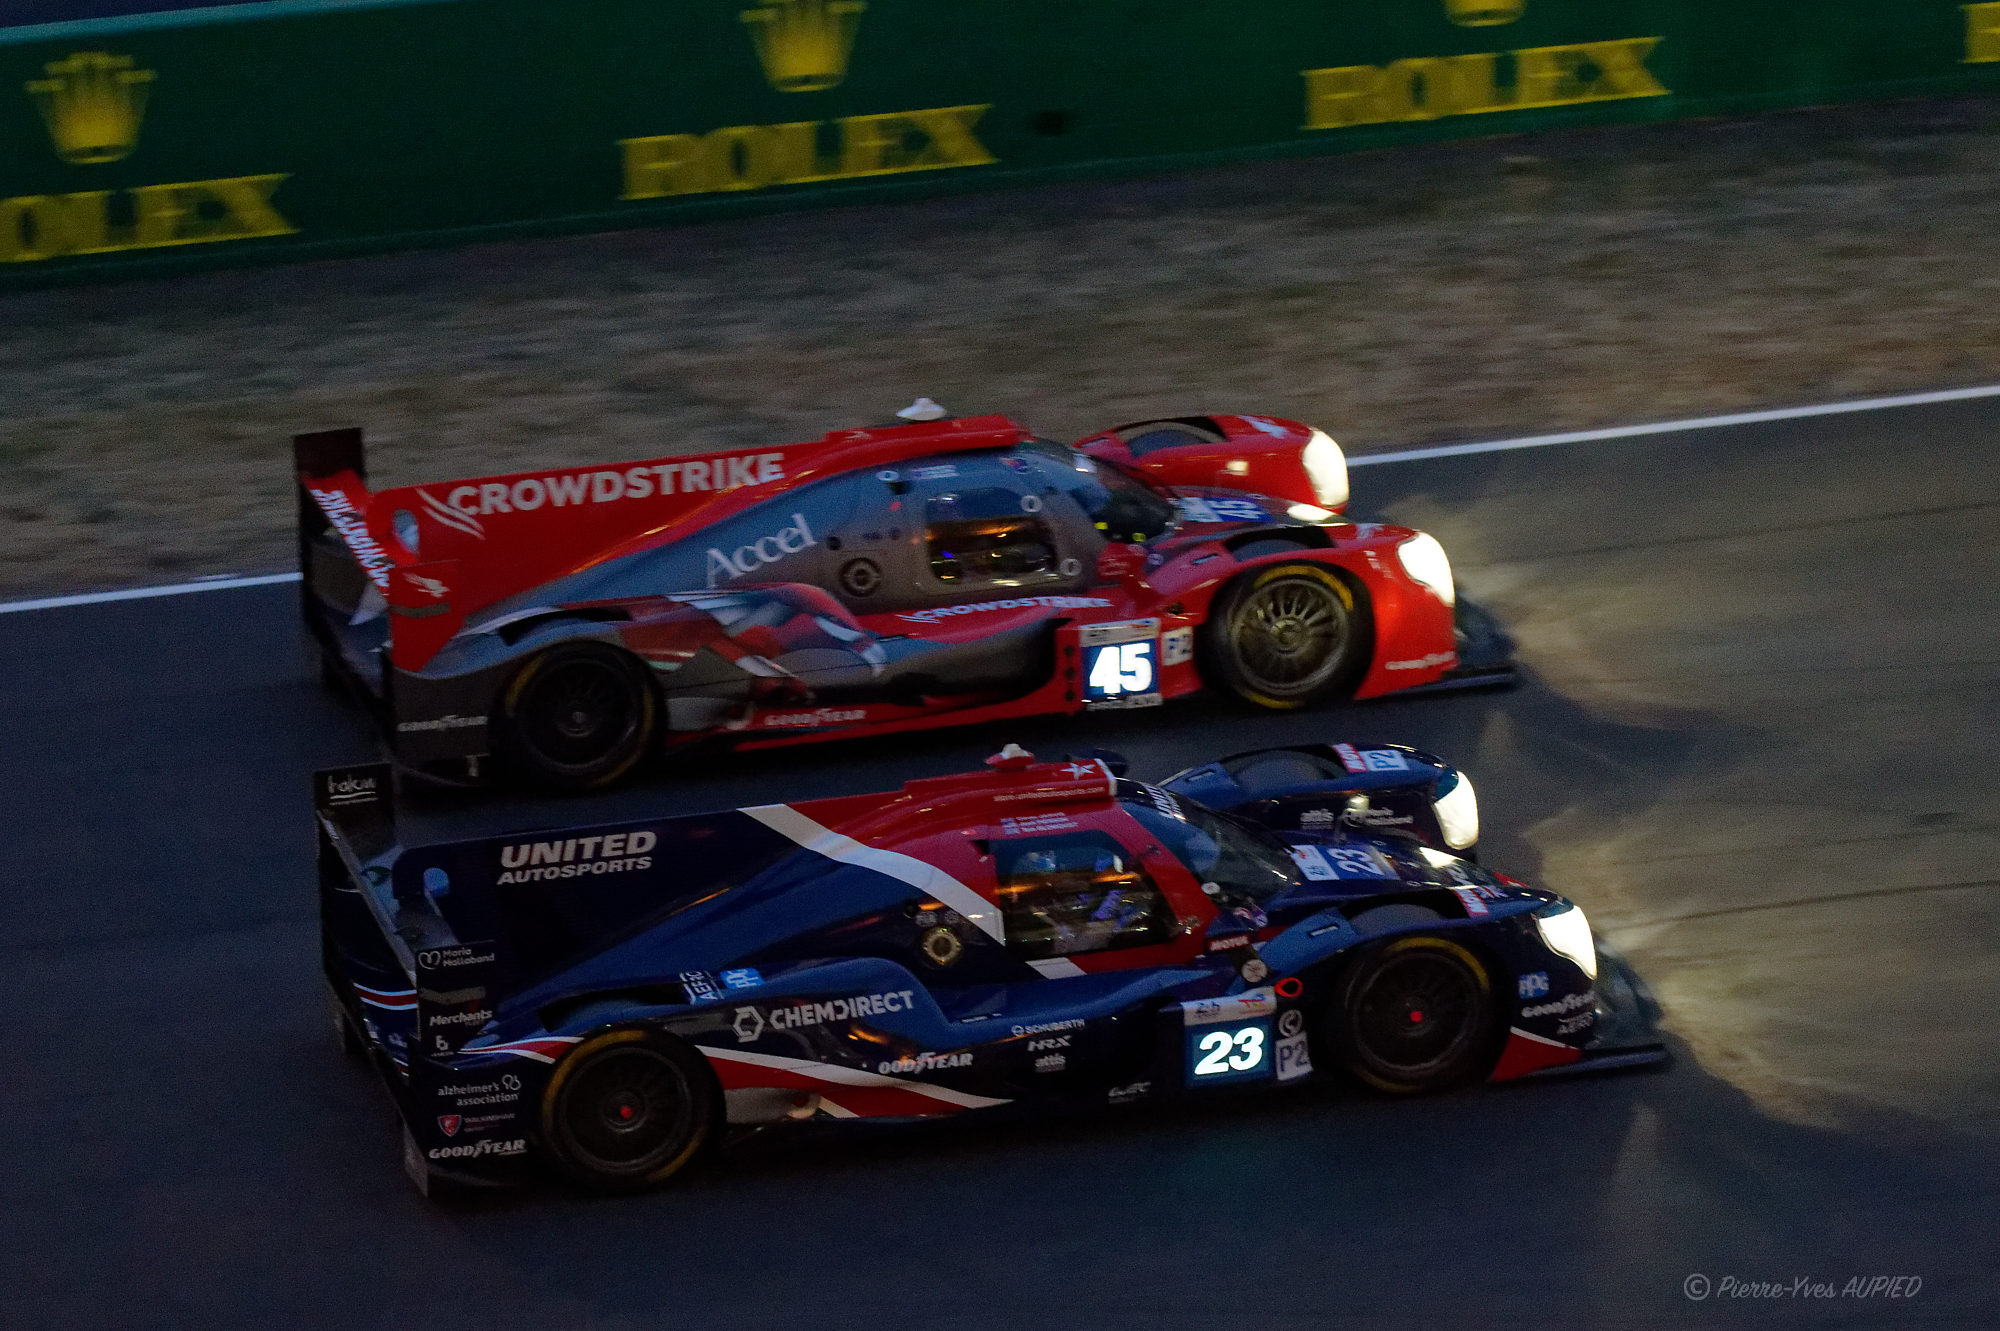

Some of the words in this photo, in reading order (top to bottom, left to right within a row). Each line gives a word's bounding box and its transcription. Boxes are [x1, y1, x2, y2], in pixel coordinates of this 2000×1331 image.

[1300, 36, 1672, 130] ROLEX
[614, 103, 1001, 200] ROLEX
[0, 172, 303, 263] OLEX
[447, 453, 785, 516] CROWDSTRIKE
[706, 513, 818, 590] Accel
[912, 596, 1115, 621] CROWDSTRIKE
[1089, 643, 1152, 693] 45
[1369, 752, 1400, 769] P2
[500, 831, 658, 868] UNITED
[1326, 848, 1385, 876] 23
[496, 856, 653, 886] AUTOSPORTS
[429, 1009, 494, 1027] Merchants
[769, 990, 914, 1030] CHEMDIRECT
[1194, 1026, 1264, 1075] 23
[1279, 1040, 1309, 1073] P2
[437, 1081, 501, 1097] alzheimer's
[456, 1092, 520, 1107] association
[428, 1138, 528, 1159] GOODYEAR
